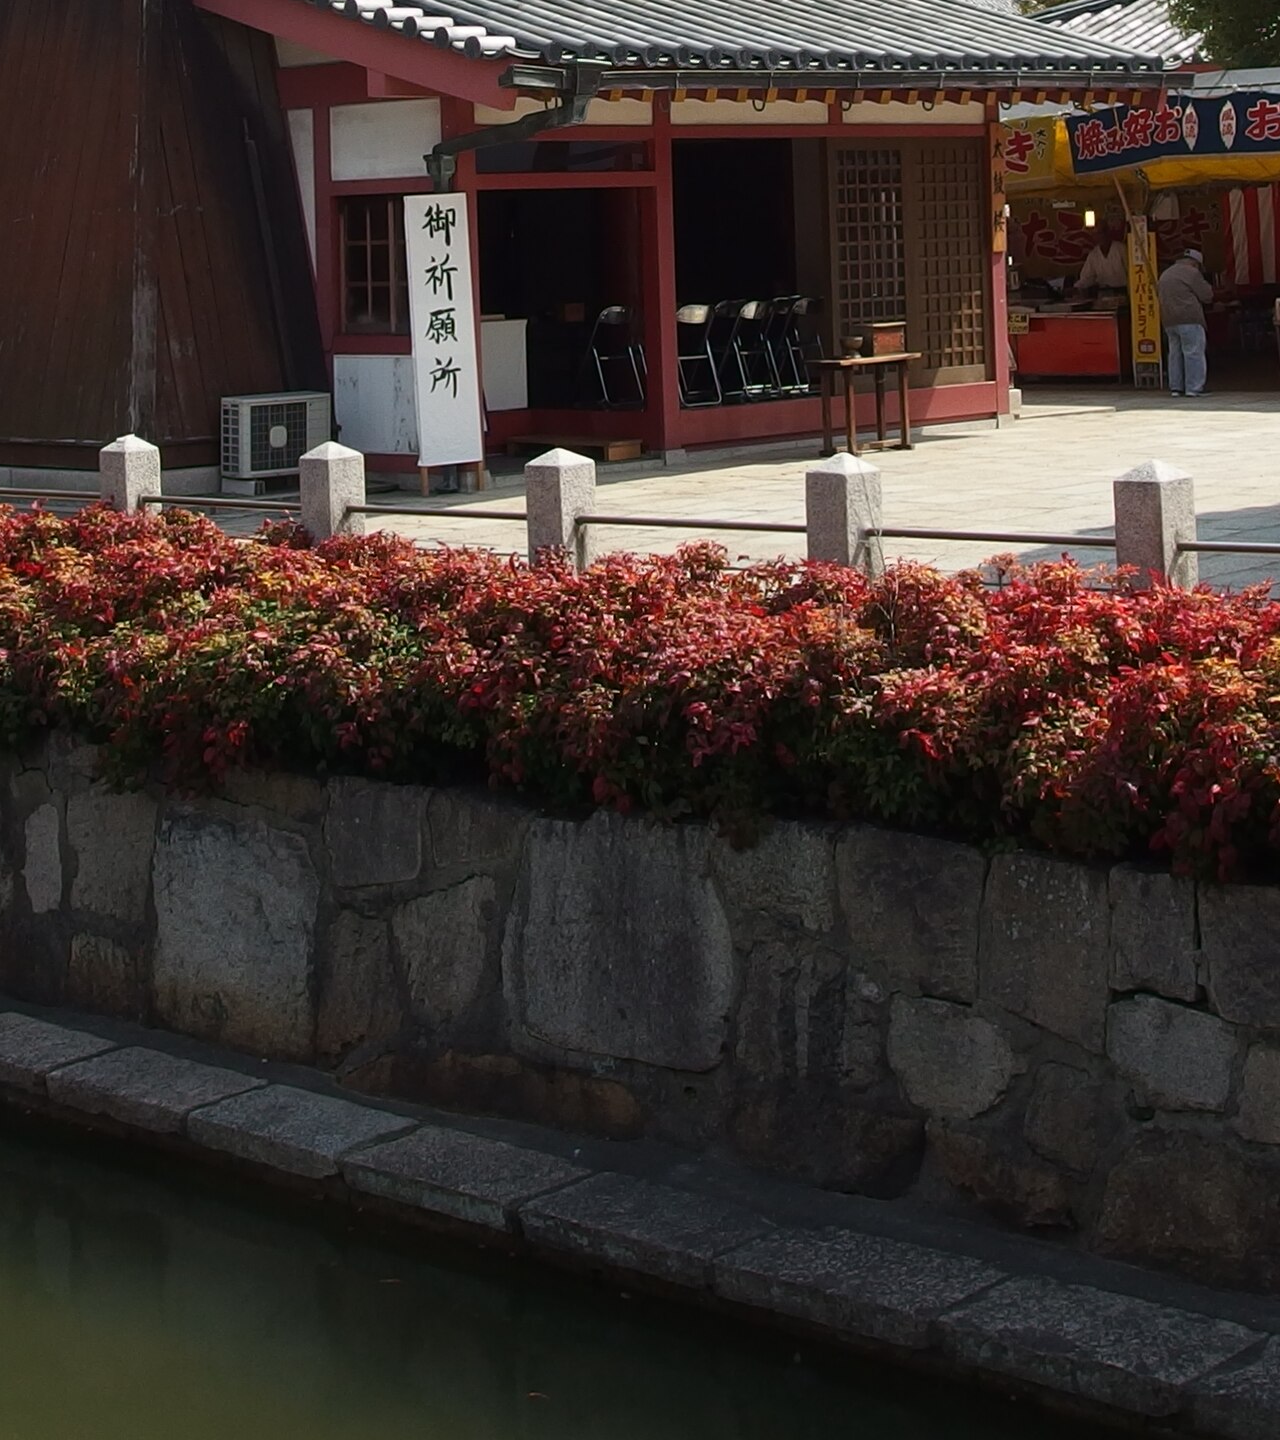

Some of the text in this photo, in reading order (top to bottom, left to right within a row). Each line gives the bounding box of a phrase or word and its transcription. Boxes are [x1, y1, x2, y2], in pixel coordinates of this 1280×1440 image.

[422, 202, 461, 399] 御祈願所
[1134, 264, 1148, 338] スーパードライ
